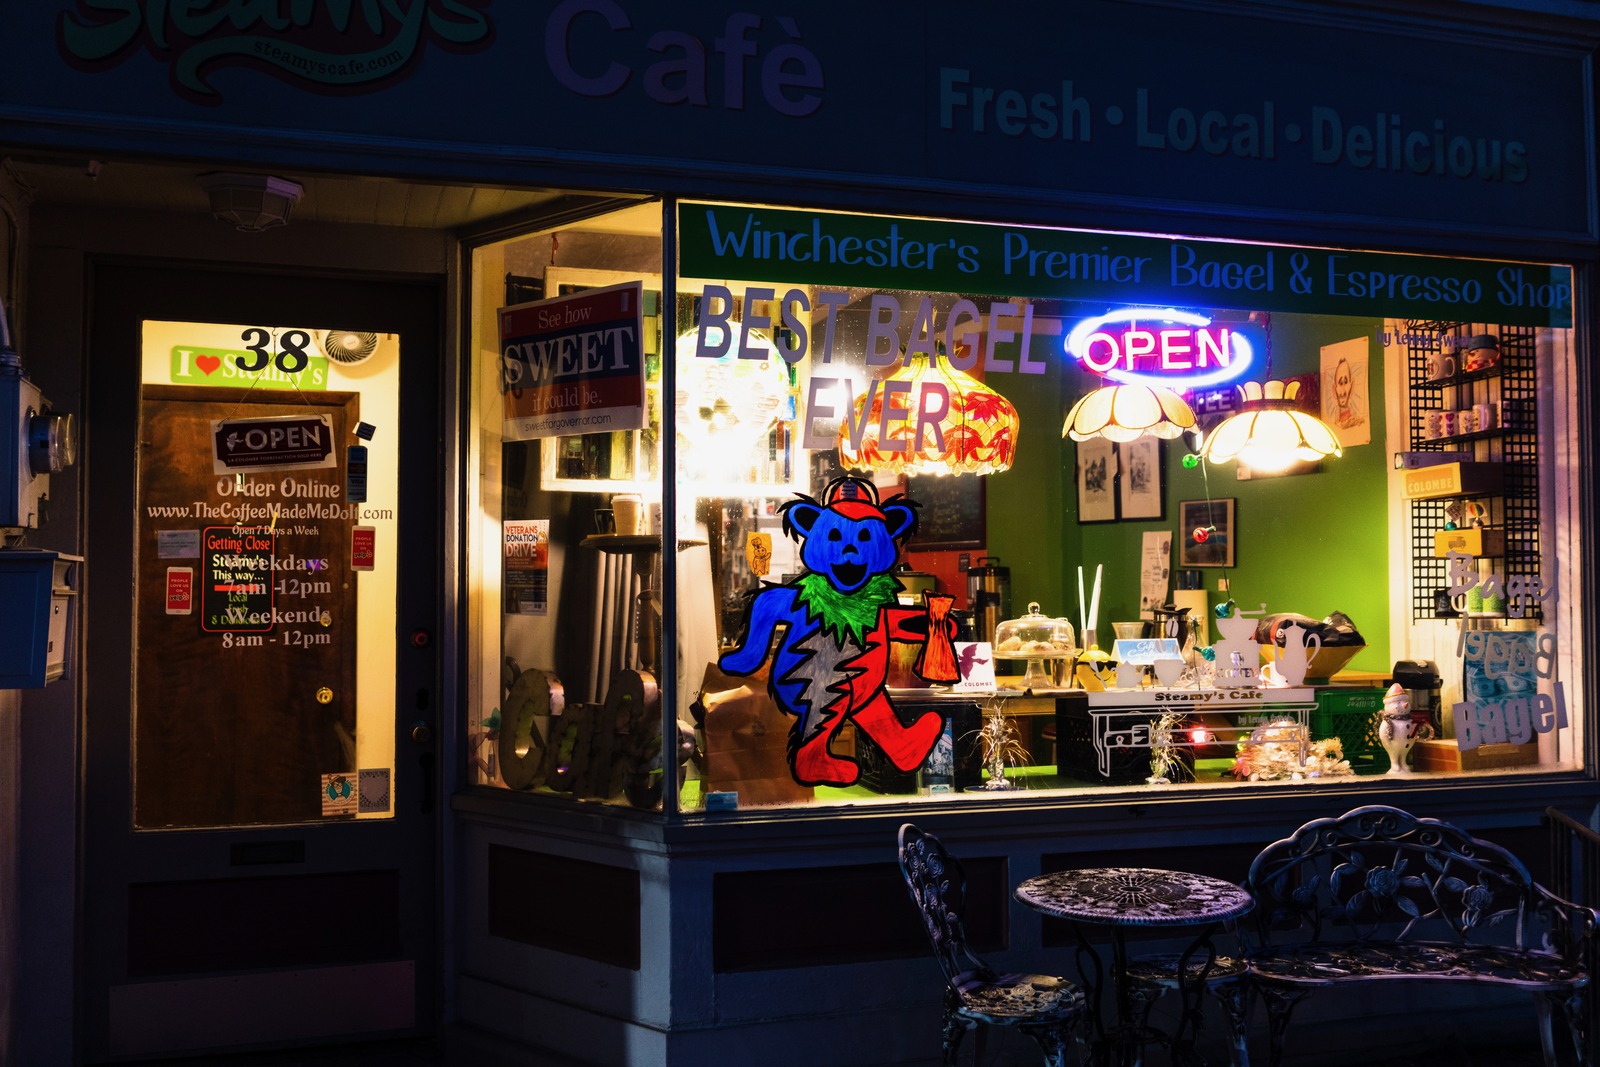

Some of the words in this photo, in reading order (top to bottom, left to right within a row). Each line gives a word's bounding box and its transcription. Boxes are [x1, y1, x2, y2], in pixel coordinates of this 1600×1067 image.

[253, 40, 404, 76] steamyscafe.com
[545, 0, 825, 117] Cafè
[939, 66, 1092, 143] Fresh
[1135, 86, 1276, 160] Local
[1311, 105, 1529, 184] Delicious
[706, 210, 980, 273] Winchester's
[1004, 232, 1152, 284] Premier
[1289, 252, 1313, 295] &
[1328, 255, 1482, 304] Espresso
[1497, 267, 1571, 309] Shop
[538, 309, 561, 329] See
[565, 305, 592, 324] how
[695, 284, 849, 365] BEST
[866, 293, 1046, 375] BAGEL
[1376, 329, 1391, 348] by
[236, 328, 310, 373] 38
[504, 326, 634, 385] SWEET
[1082, 328, 1230, 372] OPEN
[176, 350, 194, 377] I
[533, 393, 541, 412] it
[544, 386, 579, 410] could
[583, 385, 602, 404] be.
[525, 414, 612, 432] sweetforgovernor.com
[802, 377, 950, 453] EVER
[245, 426, 321, 450] OPEN
[217, 476, 276, 498] Order
[280, 477, 340, 499] Online
[1408, 478, 1453, 493] COLOMBE
[232, 525, 255, 538] Open
[256, 526, 261, 534] 7
[264, 526, 285, 538] Days
[294, 525, 319, 535] Week
[506, 525, 538, 534] VETERANS
[506, 534, 538, 542] DONATION
[207, 535, 242, 554] Getting
[245, 536, 270, 550] Close
[506, 543, 537, 558] DRIVE
[213, 569, 232, 580] This
[223, 554, 329, 575] Weekdays
[224, 579, 267, 595] 7am
[1446, 550, 1559, 618] Bagel
[228, 593, 248, 602] Local
[225, 606, 331, 624] Weekends
[222, 632, 263, 648] 8am
[283, 630, 331, 649] 12pm
[1155, 691, 1225, 702] Steamy's
[1229, 691, 1264, 700] Cafe
[1452, 681, 1569, 752] Bagel
